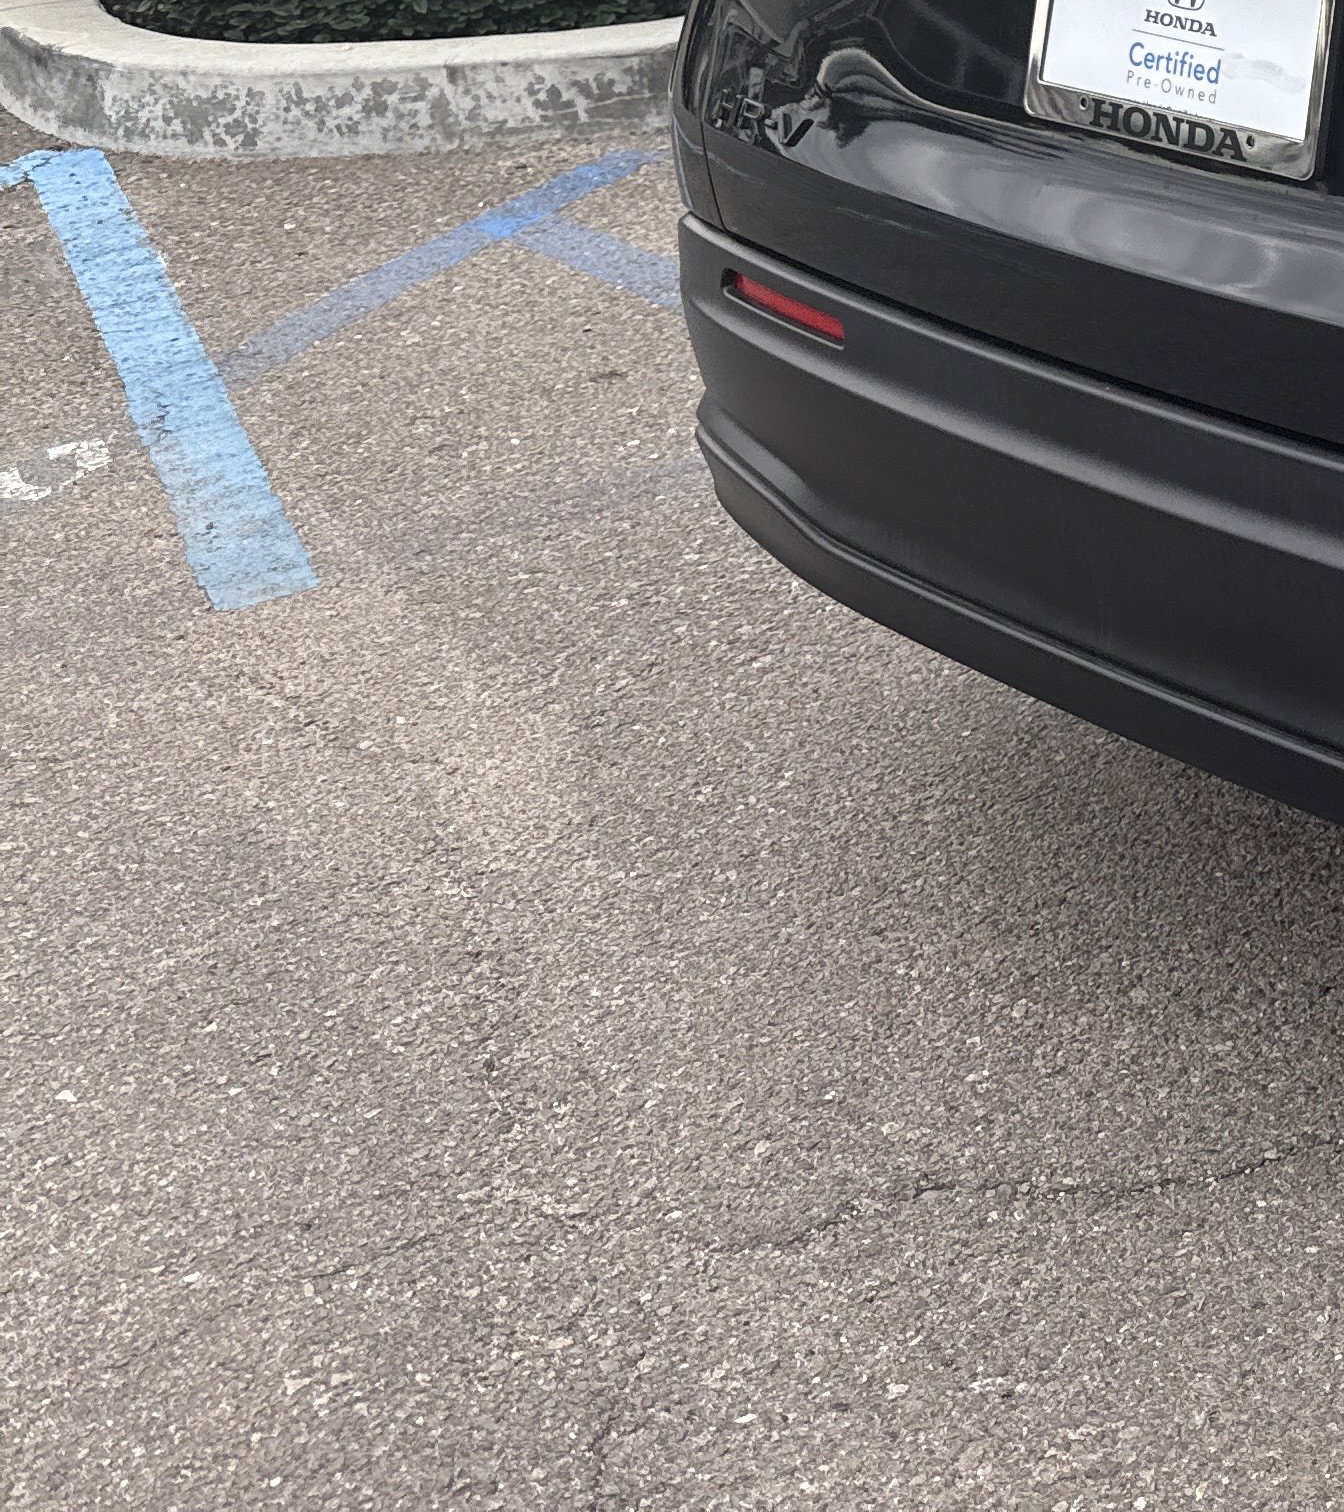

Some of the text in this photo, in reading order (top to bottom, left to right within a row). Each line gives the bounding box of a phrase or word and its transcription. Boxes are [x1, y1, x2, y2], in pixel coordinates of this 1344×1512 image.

[1144, 9, 1217, 37] HONDA
[1129, 42, 1221, 84] Certified
[1126, 70, 1217, 104] Pre-Owned
[1088, 97, 1248, 162] HONDA
